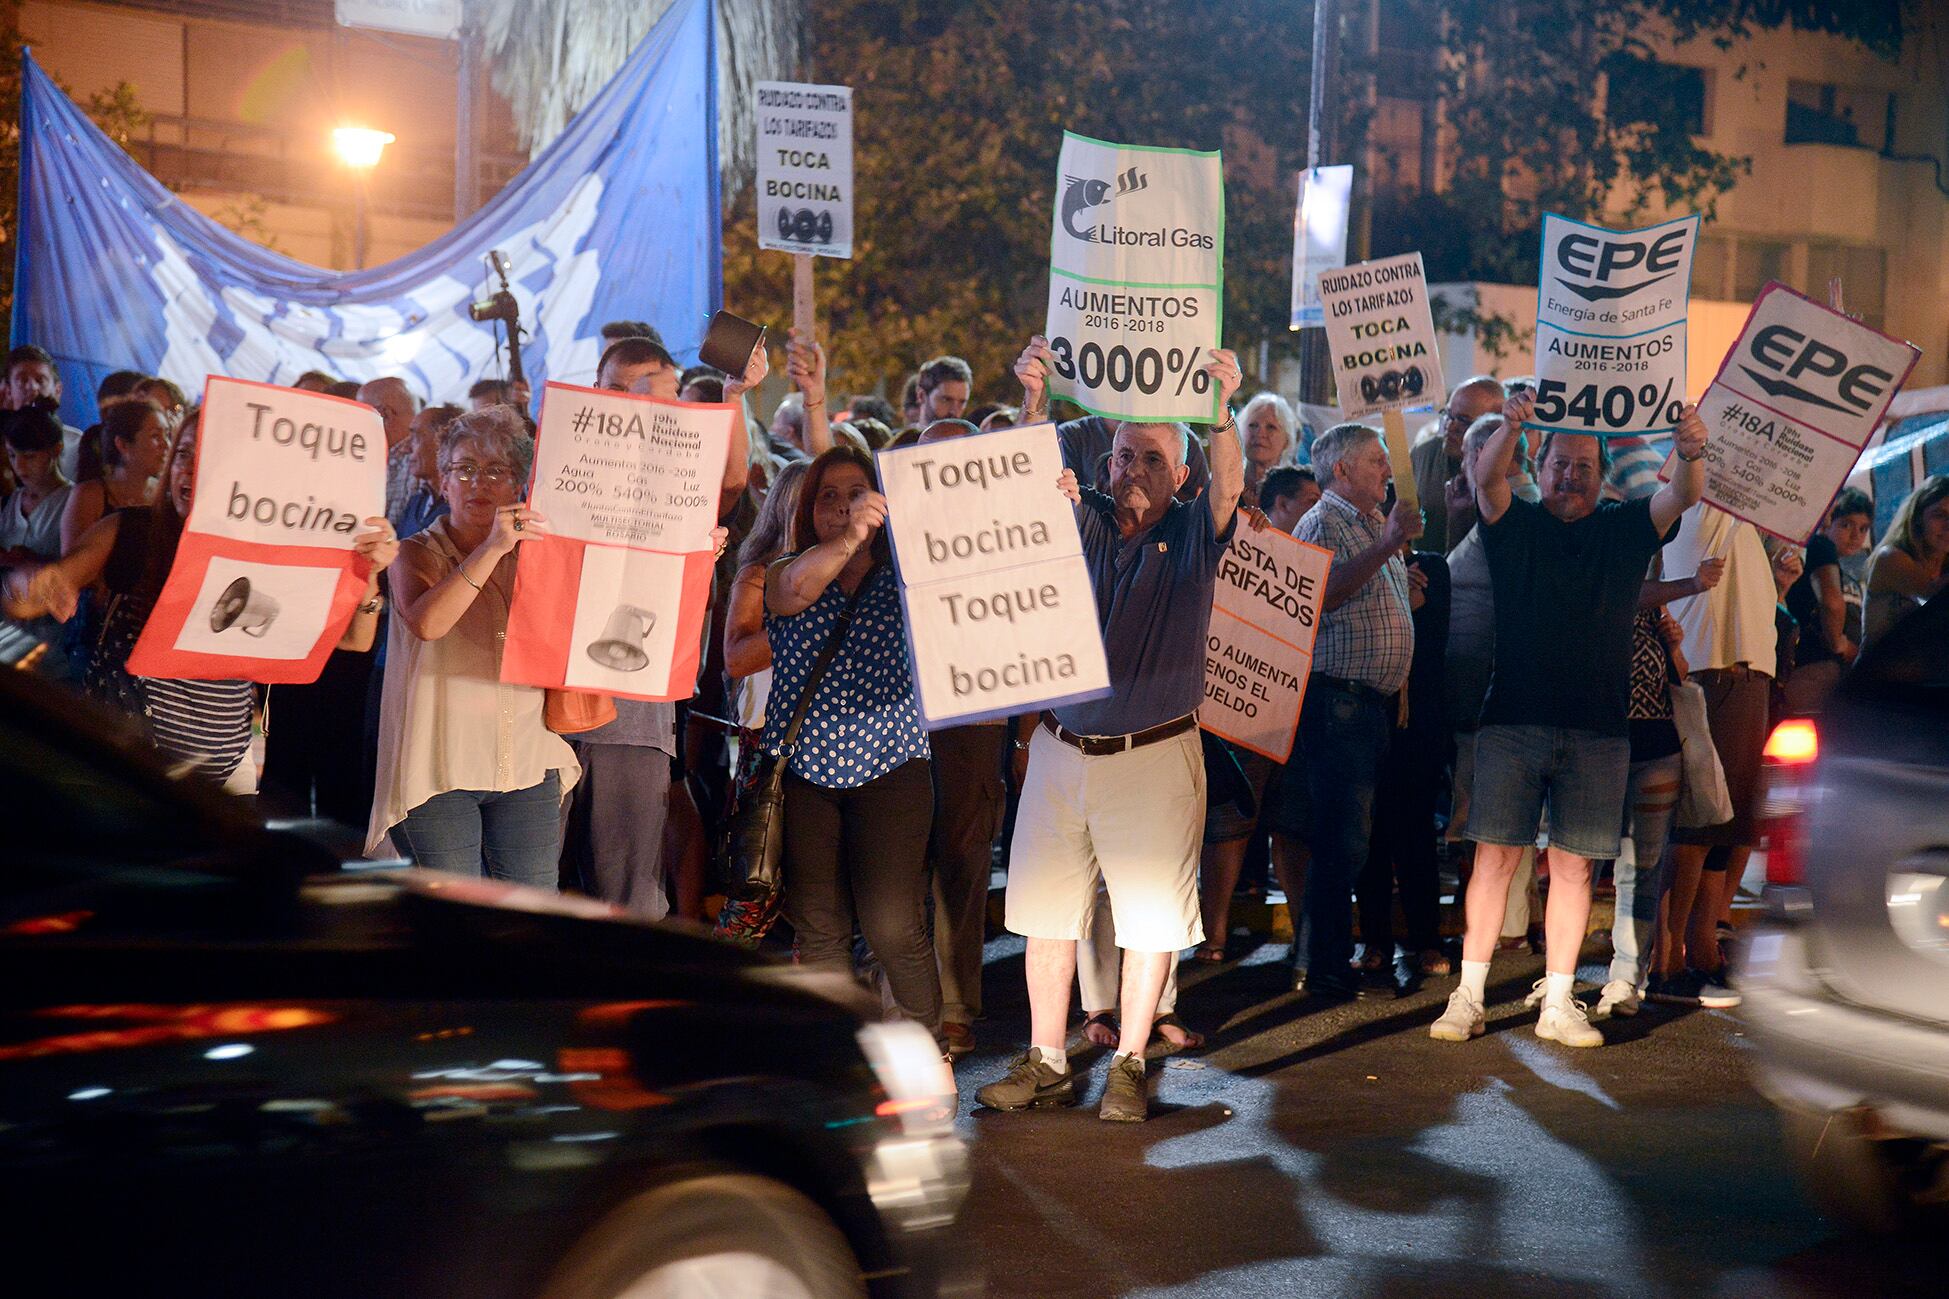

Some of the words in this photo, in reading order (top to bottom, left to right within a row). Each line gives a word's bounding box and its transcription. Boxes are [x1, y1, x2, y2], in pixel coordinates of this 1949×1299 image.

[764, 117, 782, 135] LOS
[777, 149, 831, 170] TOCA
[766, 180, 843, 202] BOCINA
[1101, 224, 1166, 247] Litoral
[1172, 228, 1214, 250] Gas
[1557, 228, 1688, 282] EPE
[1322, 271, 1372, 295] RUIDAZO
[1374, 261, 1421, 285] CONTRA
[1060, 286, 1199, 318] AUMENTOS
[1331, 300, 1353, 318] LOS
[1354, 287, 1414, 314] TARIFAZOS
[1547, 297, 1596, 322] Energía
[1600, 310, 1618, 324] de
[1621, 304, 1656, 324] Santa
[1658, 298, 1672, 313] Fe
[1085, 315, 1120, 330] 2016
[1350, 316, 1411, 340] TOCA
[1341, 341, 1427, 371] BOCINA
[1548, 334, 1674, 361] AUMENTOS
[1574, 360, 1607, 372] 2016
[1750, 324, 1894, 411] EPE
[1533, 376, 1684, 429] 540%
[246, 402, 366, 461] Toque
[572, 405, 646, 440] #18A
[652, 424, 700, 440] Ruidazo
[1721, 402, 1776, 442] #18A
[650, 435, 702, 450] Nacional
[1717, 434, 1758, 459] Aumentos
[1774, 439, 1814, 463] Nacional
[1779, 433, 1814, 454] Ruidazo
[561, 464, 594, 479] Agua
[580, 454, 637, 470] Aumentos
[912, 451, 1032, 492] Toque
[1746, 460, 1762, 473] Gas
[554, 478, 603, 496] 200%
[614, 486, 658, 503] 540%
[664, 494, 708, 508] 3000%
[627, 472, 648, 486] Gas
[683, 481, 700, 492] Luz
[1701, 450, 1726, 468] 00%
[1730, 464, 1764, 488] 540%
[1767, 482, 1807, 508] 3000%
[1784, 478, 1802, 492] Luz
[227, 480, 358, 534] bocina
[924, 518, 1050, 564] bocina
[1228, 538, 1278, 578] ASTA
[1284, 566, 1315, 600] DE
[939, 583, 1060, 626] Toque
[1216, 559, 1314, 628] RIFAZOS
[949, 652, 1077, 697] bocina
[1206, 657, 1248, 690] ENOS
[1250, 681, 1270, 702] EL
[1222, 644, 1300, 692] AUMENTA
[1205, 681, 1258, 718] UELDO
